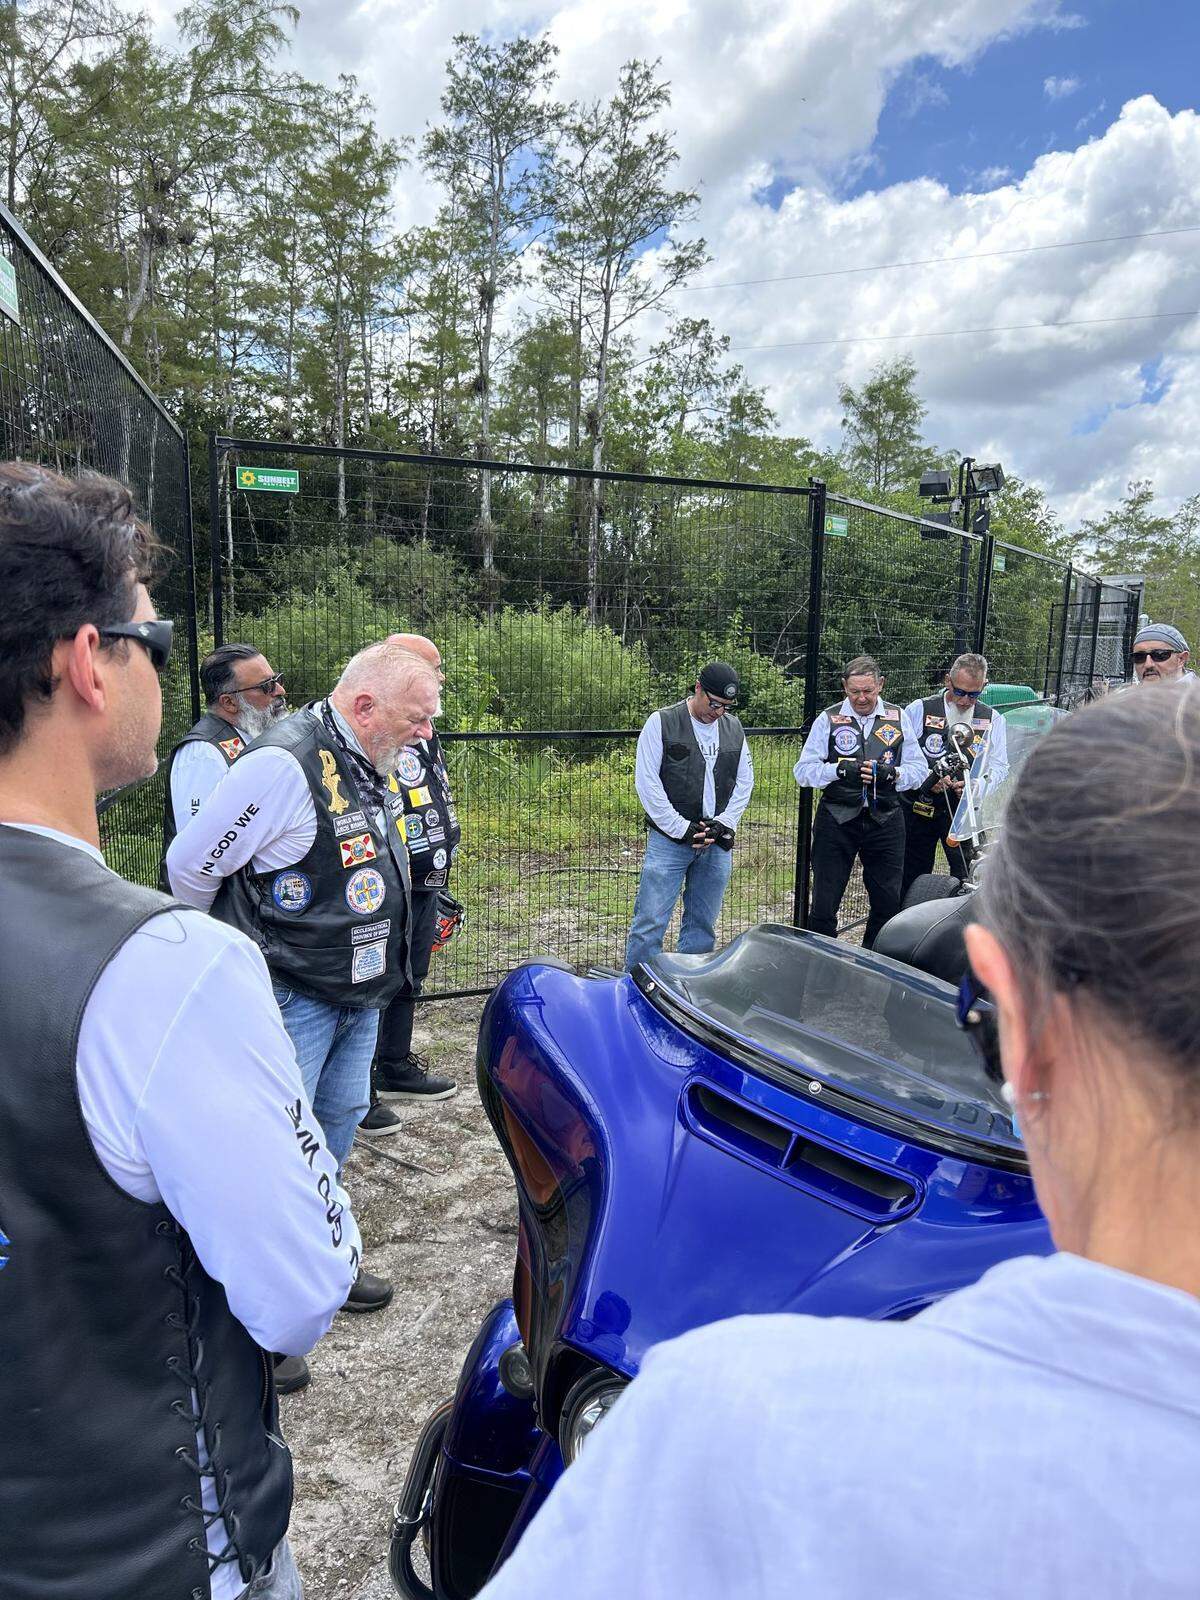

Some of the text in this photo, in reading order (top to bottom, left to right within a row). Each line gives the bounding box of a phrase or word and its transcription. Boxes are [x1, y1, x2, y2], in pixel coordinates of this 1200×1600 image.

[258, 475, 296, 485] SUNBELT
[200, 803, 260, 876] IN GOD WE
[336, 816, 352, 827] WORLD
[354, 922, 388, 935] ECCLESIASTICAL
[285, 1098, 320, 1171] WE
[318, 1172, 344, 1249] GOD
